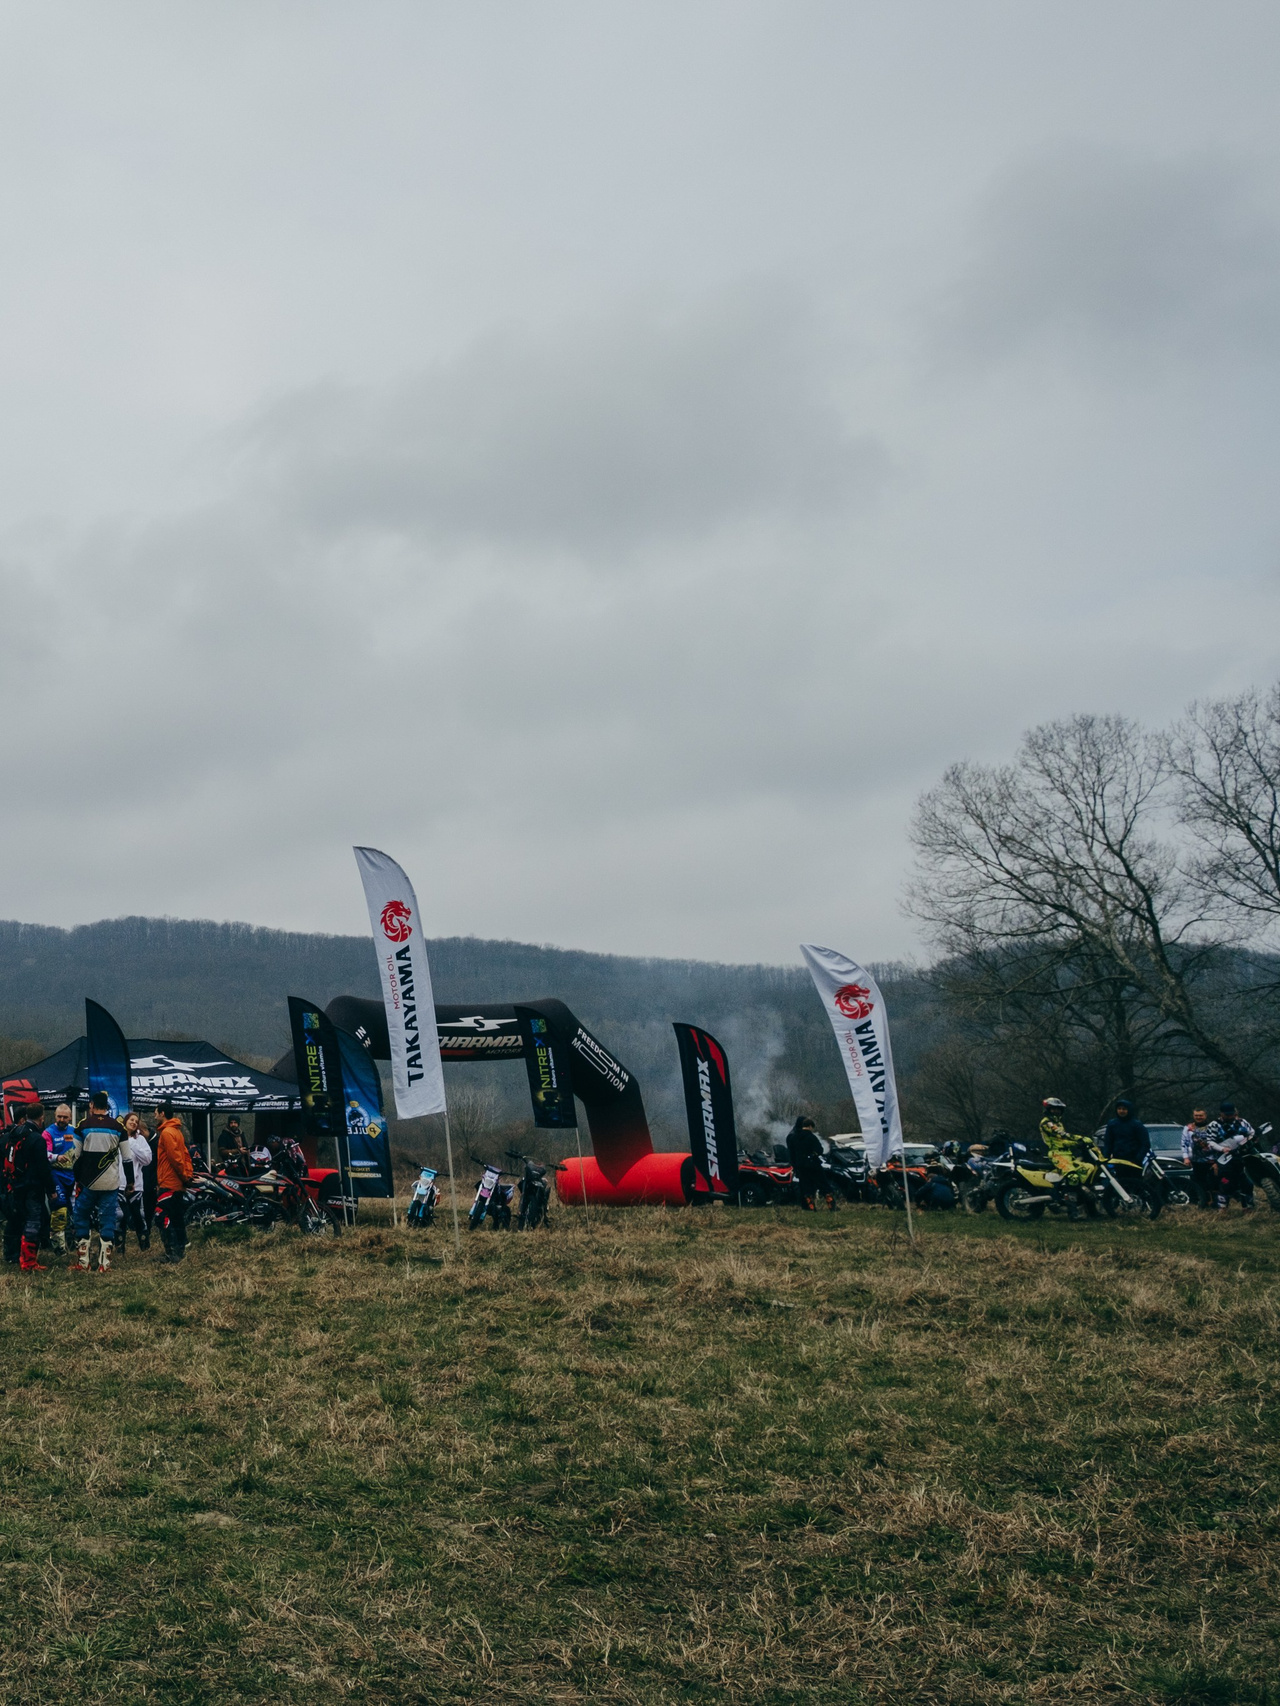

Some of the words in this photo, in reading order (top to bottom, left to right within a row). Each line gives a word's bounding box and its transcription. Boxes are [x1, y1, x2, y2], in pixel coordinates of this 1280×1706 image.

[386, 954, 395, 972] OIL
[389, 972, 400, 1010] MOTOR
[395, 944, 424, 1088] TAKAYAMA
[844, 1030, 854, 1044] OIL
[304, 1032, 322, 1092] NITREX
[318, 1045, 326, 1070] vitamins
[534, 1037, 552, 1089] NITREX
[848, 1046, 864, 1077] MOTOR
[621, 1069, 629, 1083] IN
[696, 1056, 720, 1181] SHARMAX
